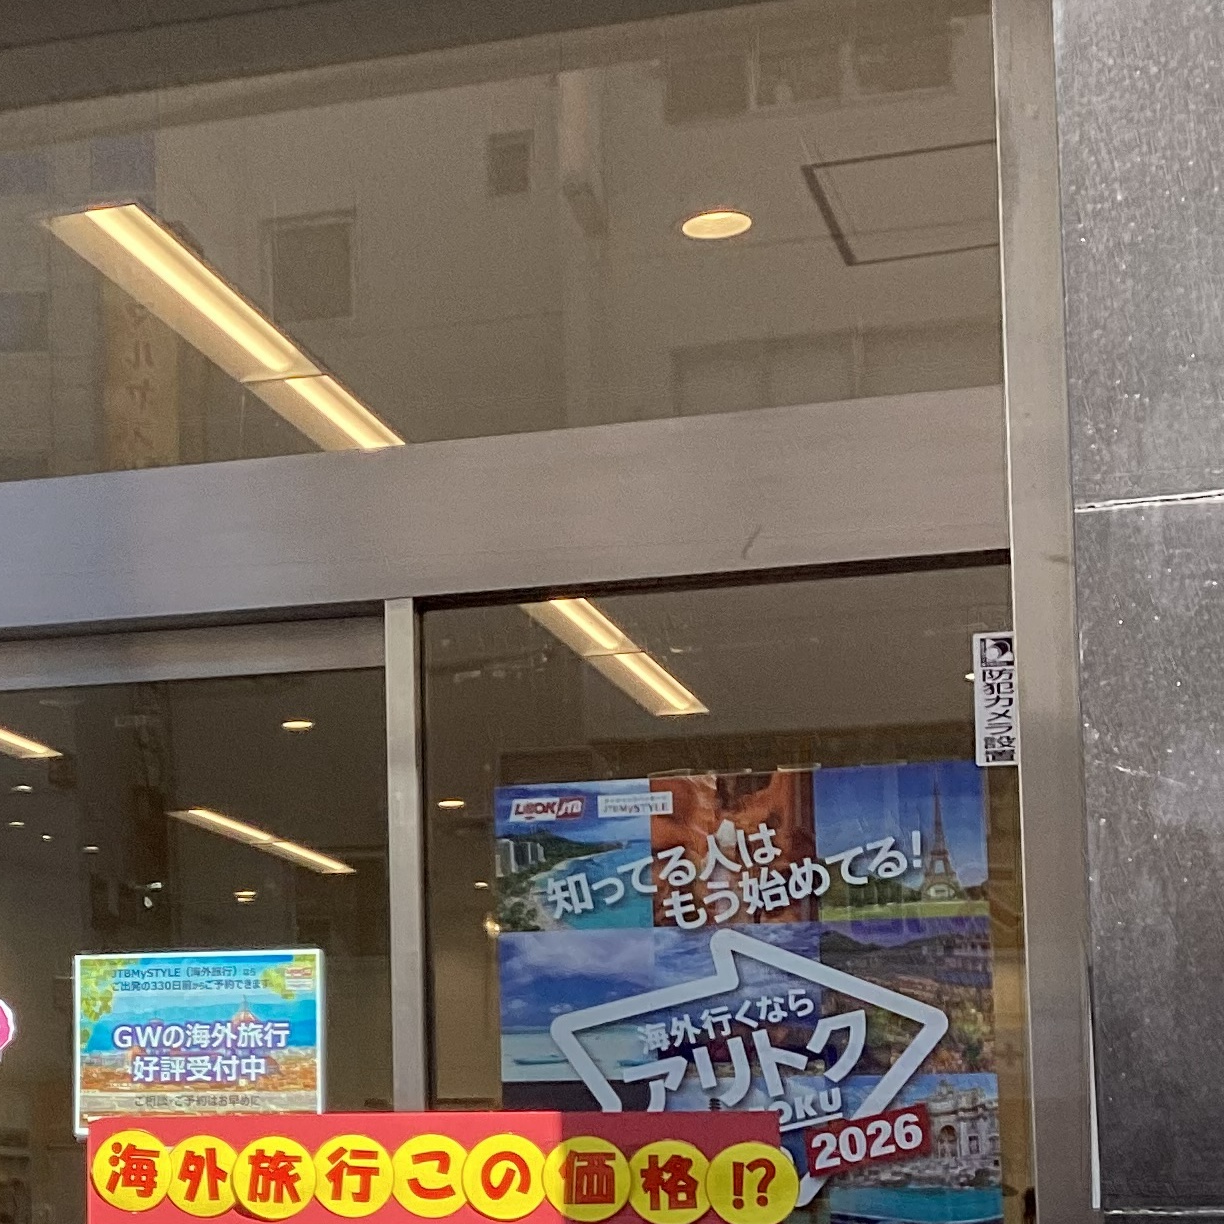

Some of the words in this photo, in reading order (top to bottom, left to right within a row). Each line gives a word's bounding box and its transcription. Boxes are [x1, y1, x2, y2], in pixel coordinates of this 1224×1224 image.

[982, 668, 1016, 763] 防犯カメラ設置
[547, 824, 781, 919] 知ってる人は
[113, 1023, 291, 1049] GWの海外旅行
[637, 988, 815, 1054] 海外行くなら
[132, 1056, 267, 1083] 好評受付中
[622, 1009, 867, 1112] アリトク
[811, 1113, 924, 1171] 2026
